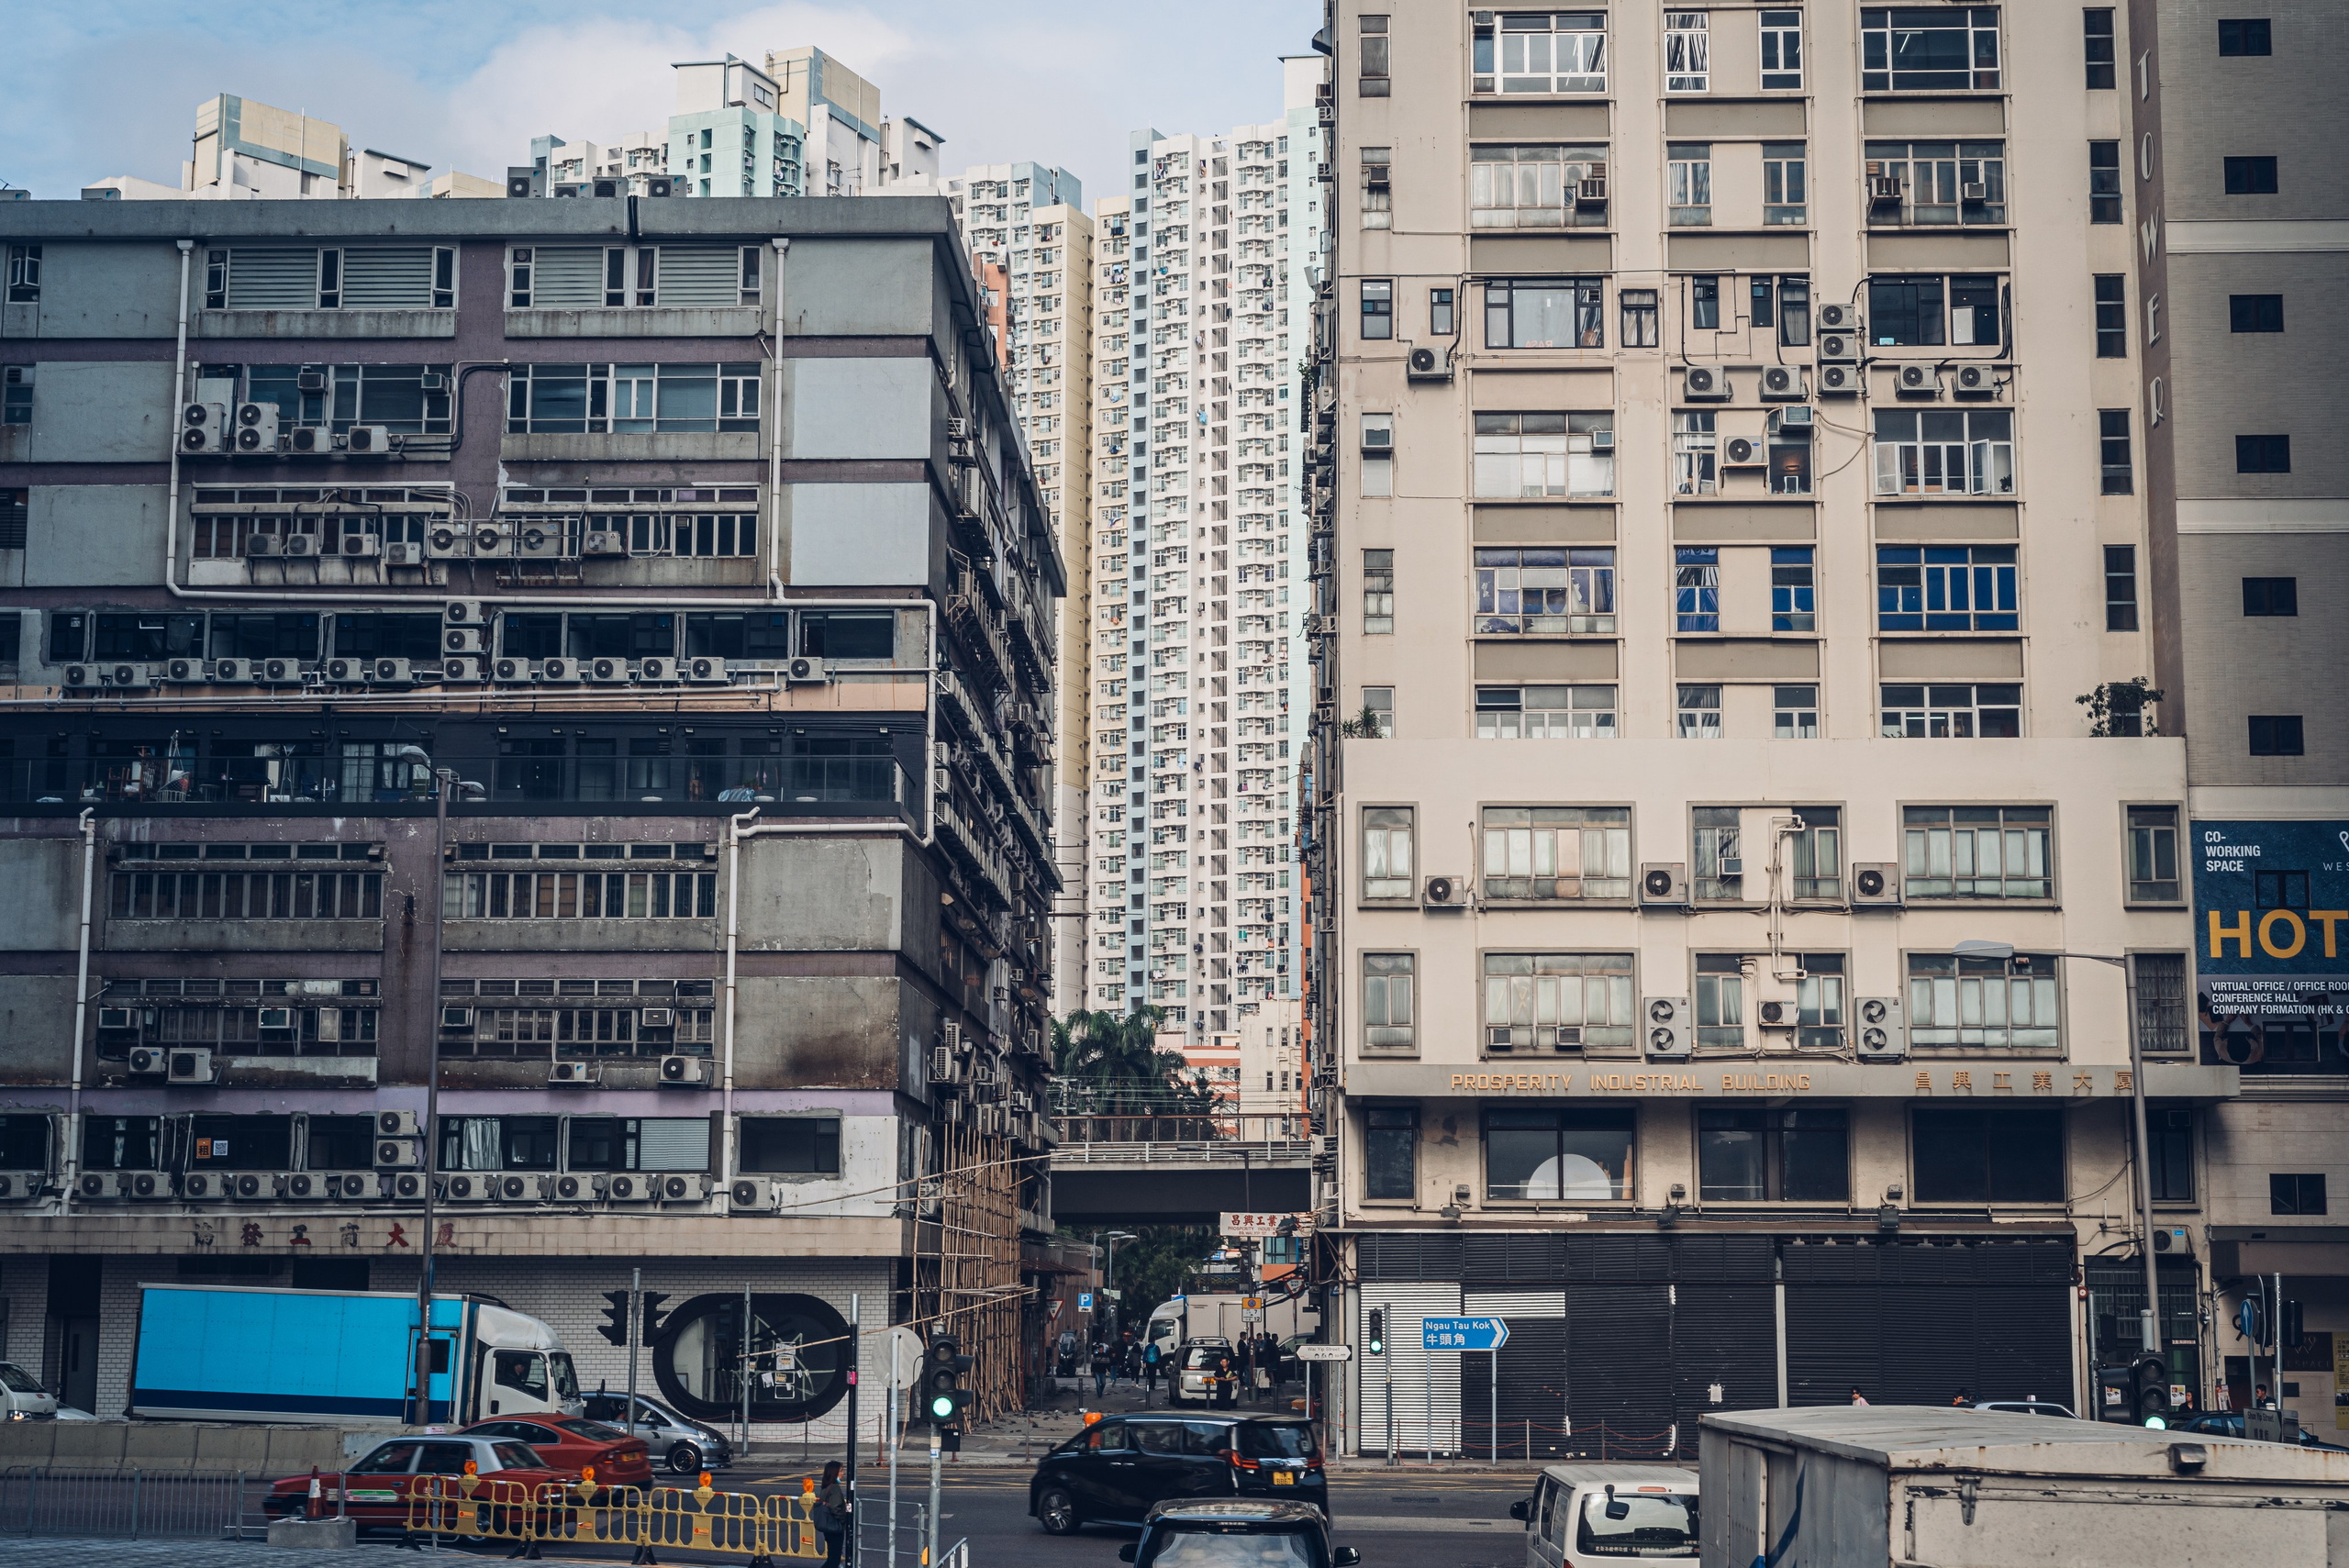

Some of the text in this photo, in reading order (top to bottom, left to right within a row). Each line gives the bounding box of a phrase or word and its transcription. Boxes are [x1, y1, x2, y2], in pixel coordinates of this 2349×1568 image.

[2137, 49, 2165, 428] TOWER
[2205, 830, 2226, 842] CO-
[2205, 845, 2261, 857] WORKING
[2206, 860, 2244, 872] SPACE
[2209, 908, 2349, 959] HOT
[2211, 982, 2250, 991] VIRTUAL
[2253, 982, 2285, 991] OFFICE
[2294, 982, 2326, 991] OFFICE
[2328, 982, 2349, 991] ROO
[2212, 994, 2299, 1003] CONFERENCE HALL
[2212, 1005, 2258, 1015] COMPANY
[2261, 1005, 2315, 1015] FORMATION
[2318, 1005, 2334, 1017] (HK
[2336, 1006, 2343, 1015] &
[1451, 1074, 1810, 1090] PROSPERITY INDUSTRIAL BUILDING
[1425, 1321, 1490, 1331] Ngau Tau Kok
[1426, 1333, 1465, 1346] 牛頭角
[2247, 1411, 2256, 1419] Shun
